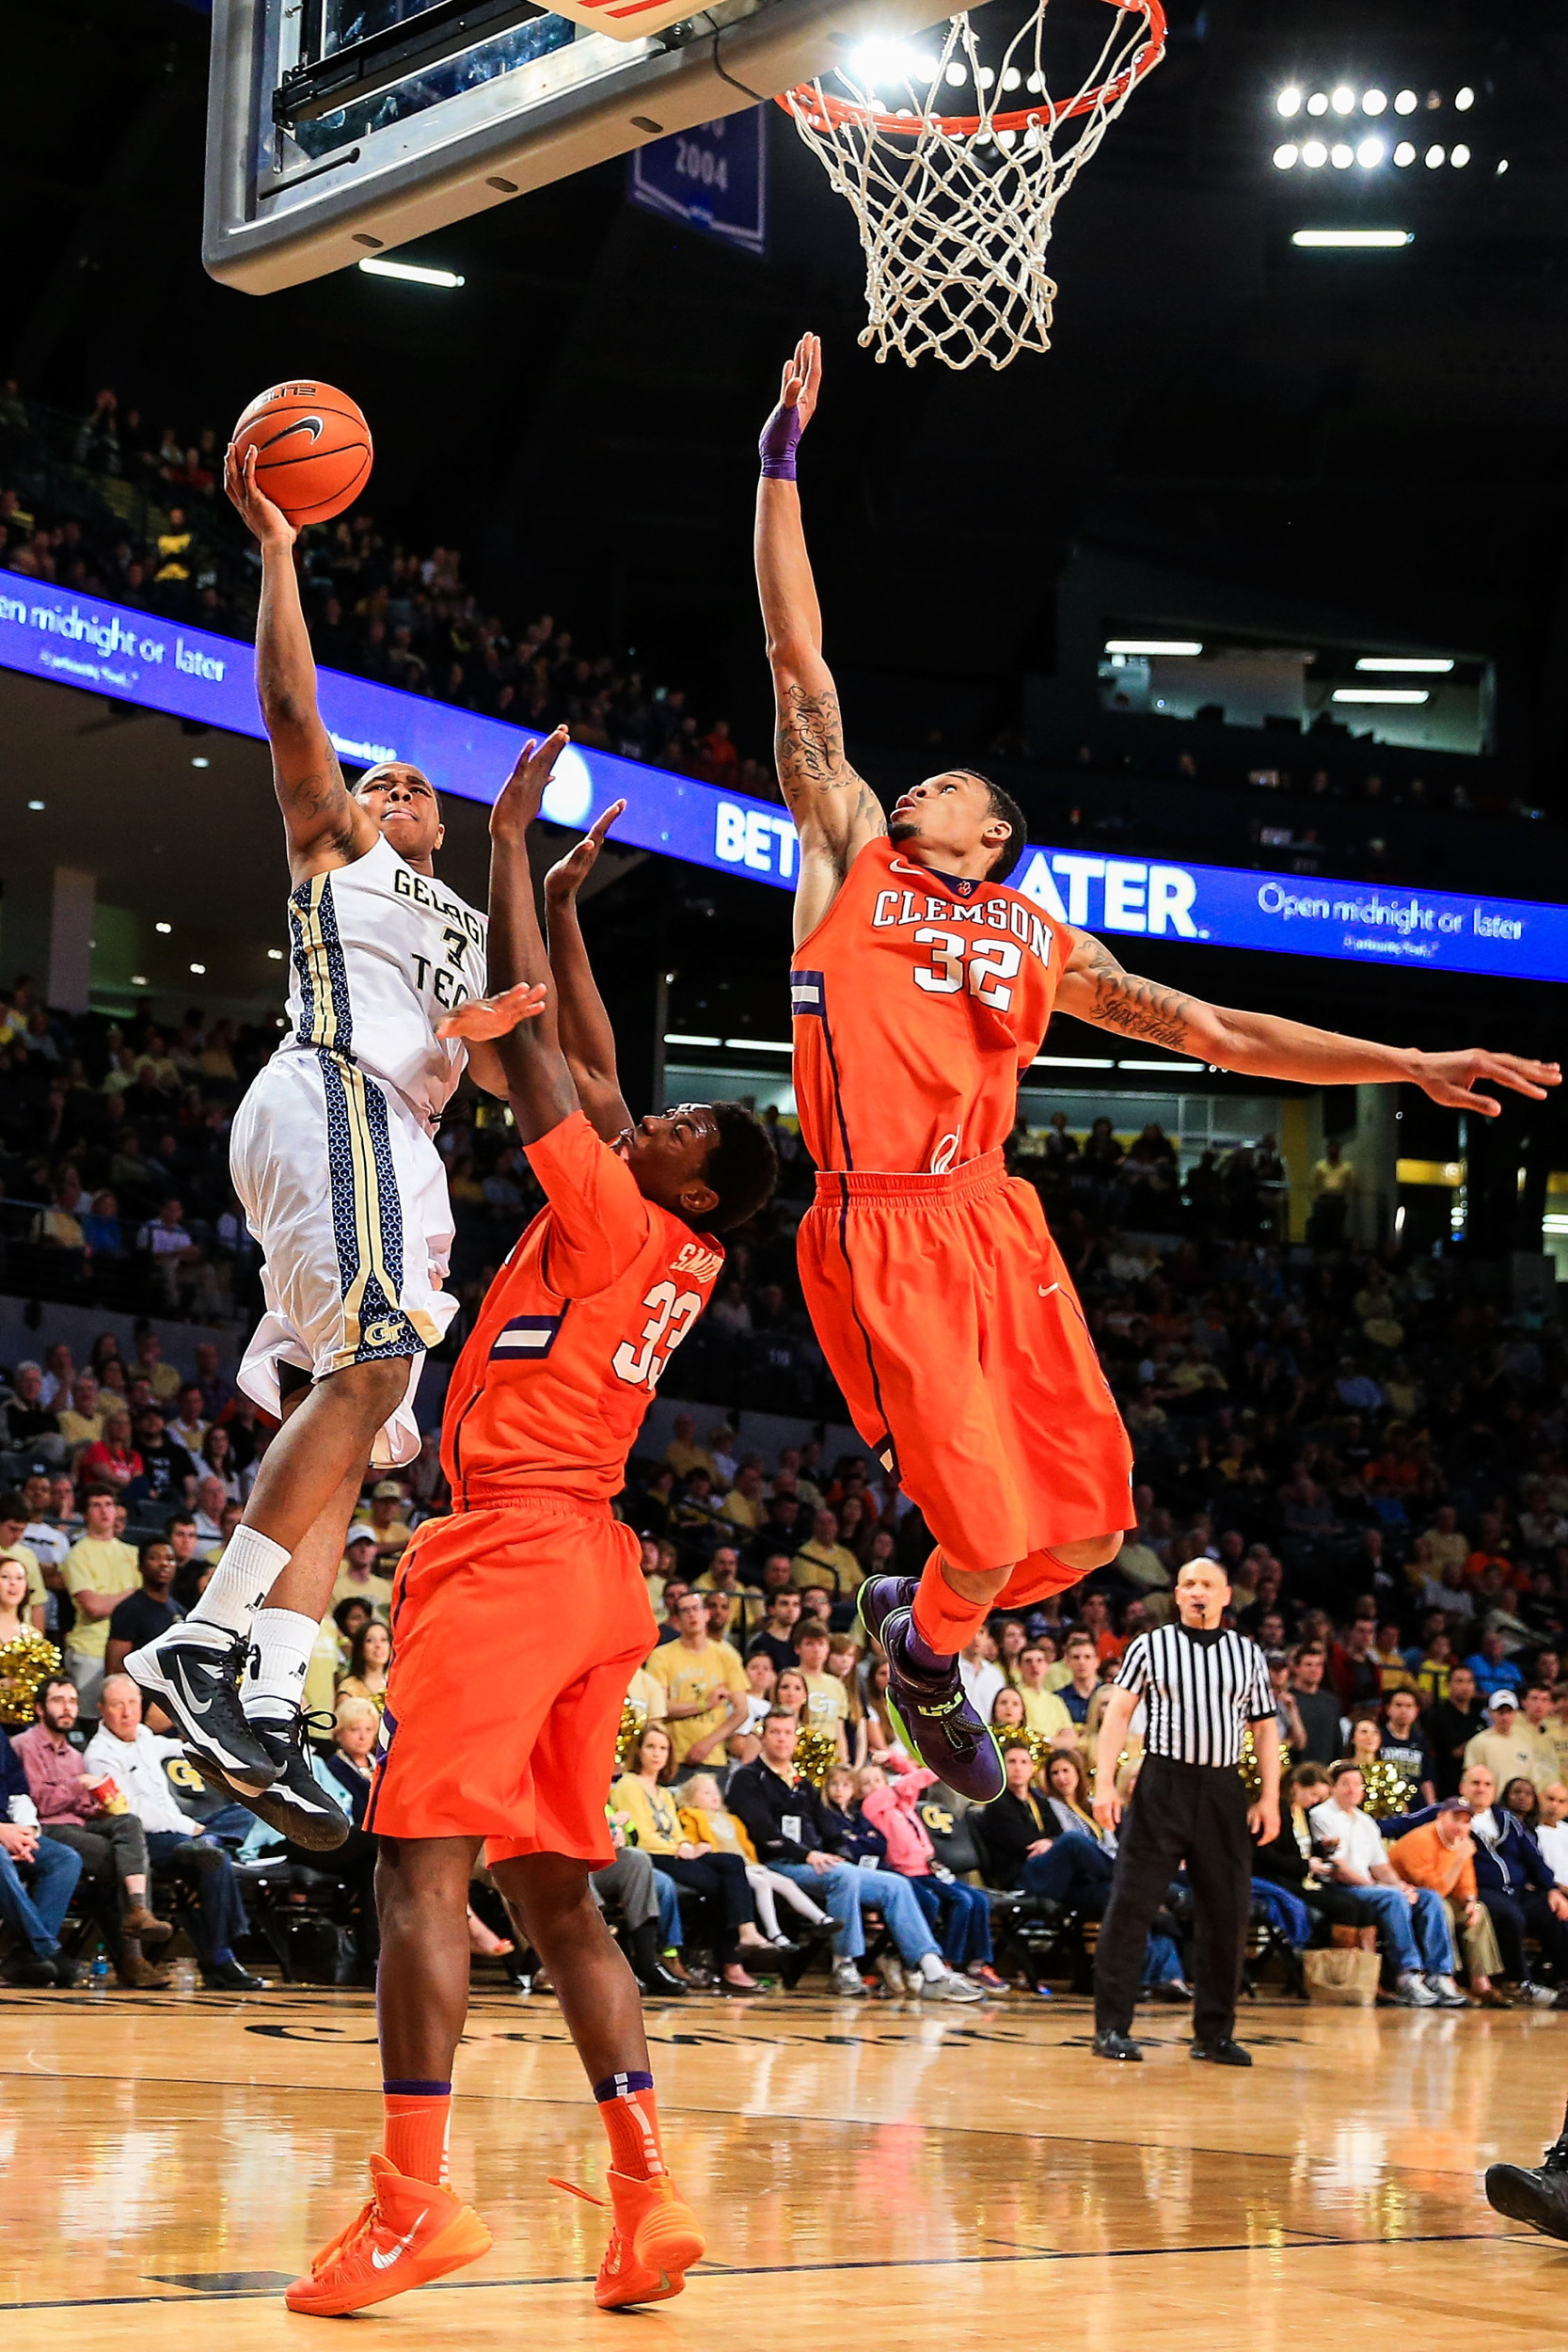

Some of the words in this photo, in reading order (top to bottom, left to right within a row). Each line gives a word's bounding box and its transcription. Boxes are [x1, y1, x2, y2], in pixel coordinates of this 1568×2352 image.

[675, 138, 728, 192] 2004
[30, 605, 137, 658] midnight
[139, 638, 166, 664] or
[175, 637, 225, 682] later
[715, 801, 800, 878] BET
[872, 890, 1053, 969] CLEMSON
[1258, 882, 1330, 921] Open
[1332, 896, 1435, 935] midnight
[1437, 912, 1463, 933] or
[1473, 905, 1523, 940] later
[912, 927, 1023, 1013] 32
[611, 1279, 703, 1391] 33
